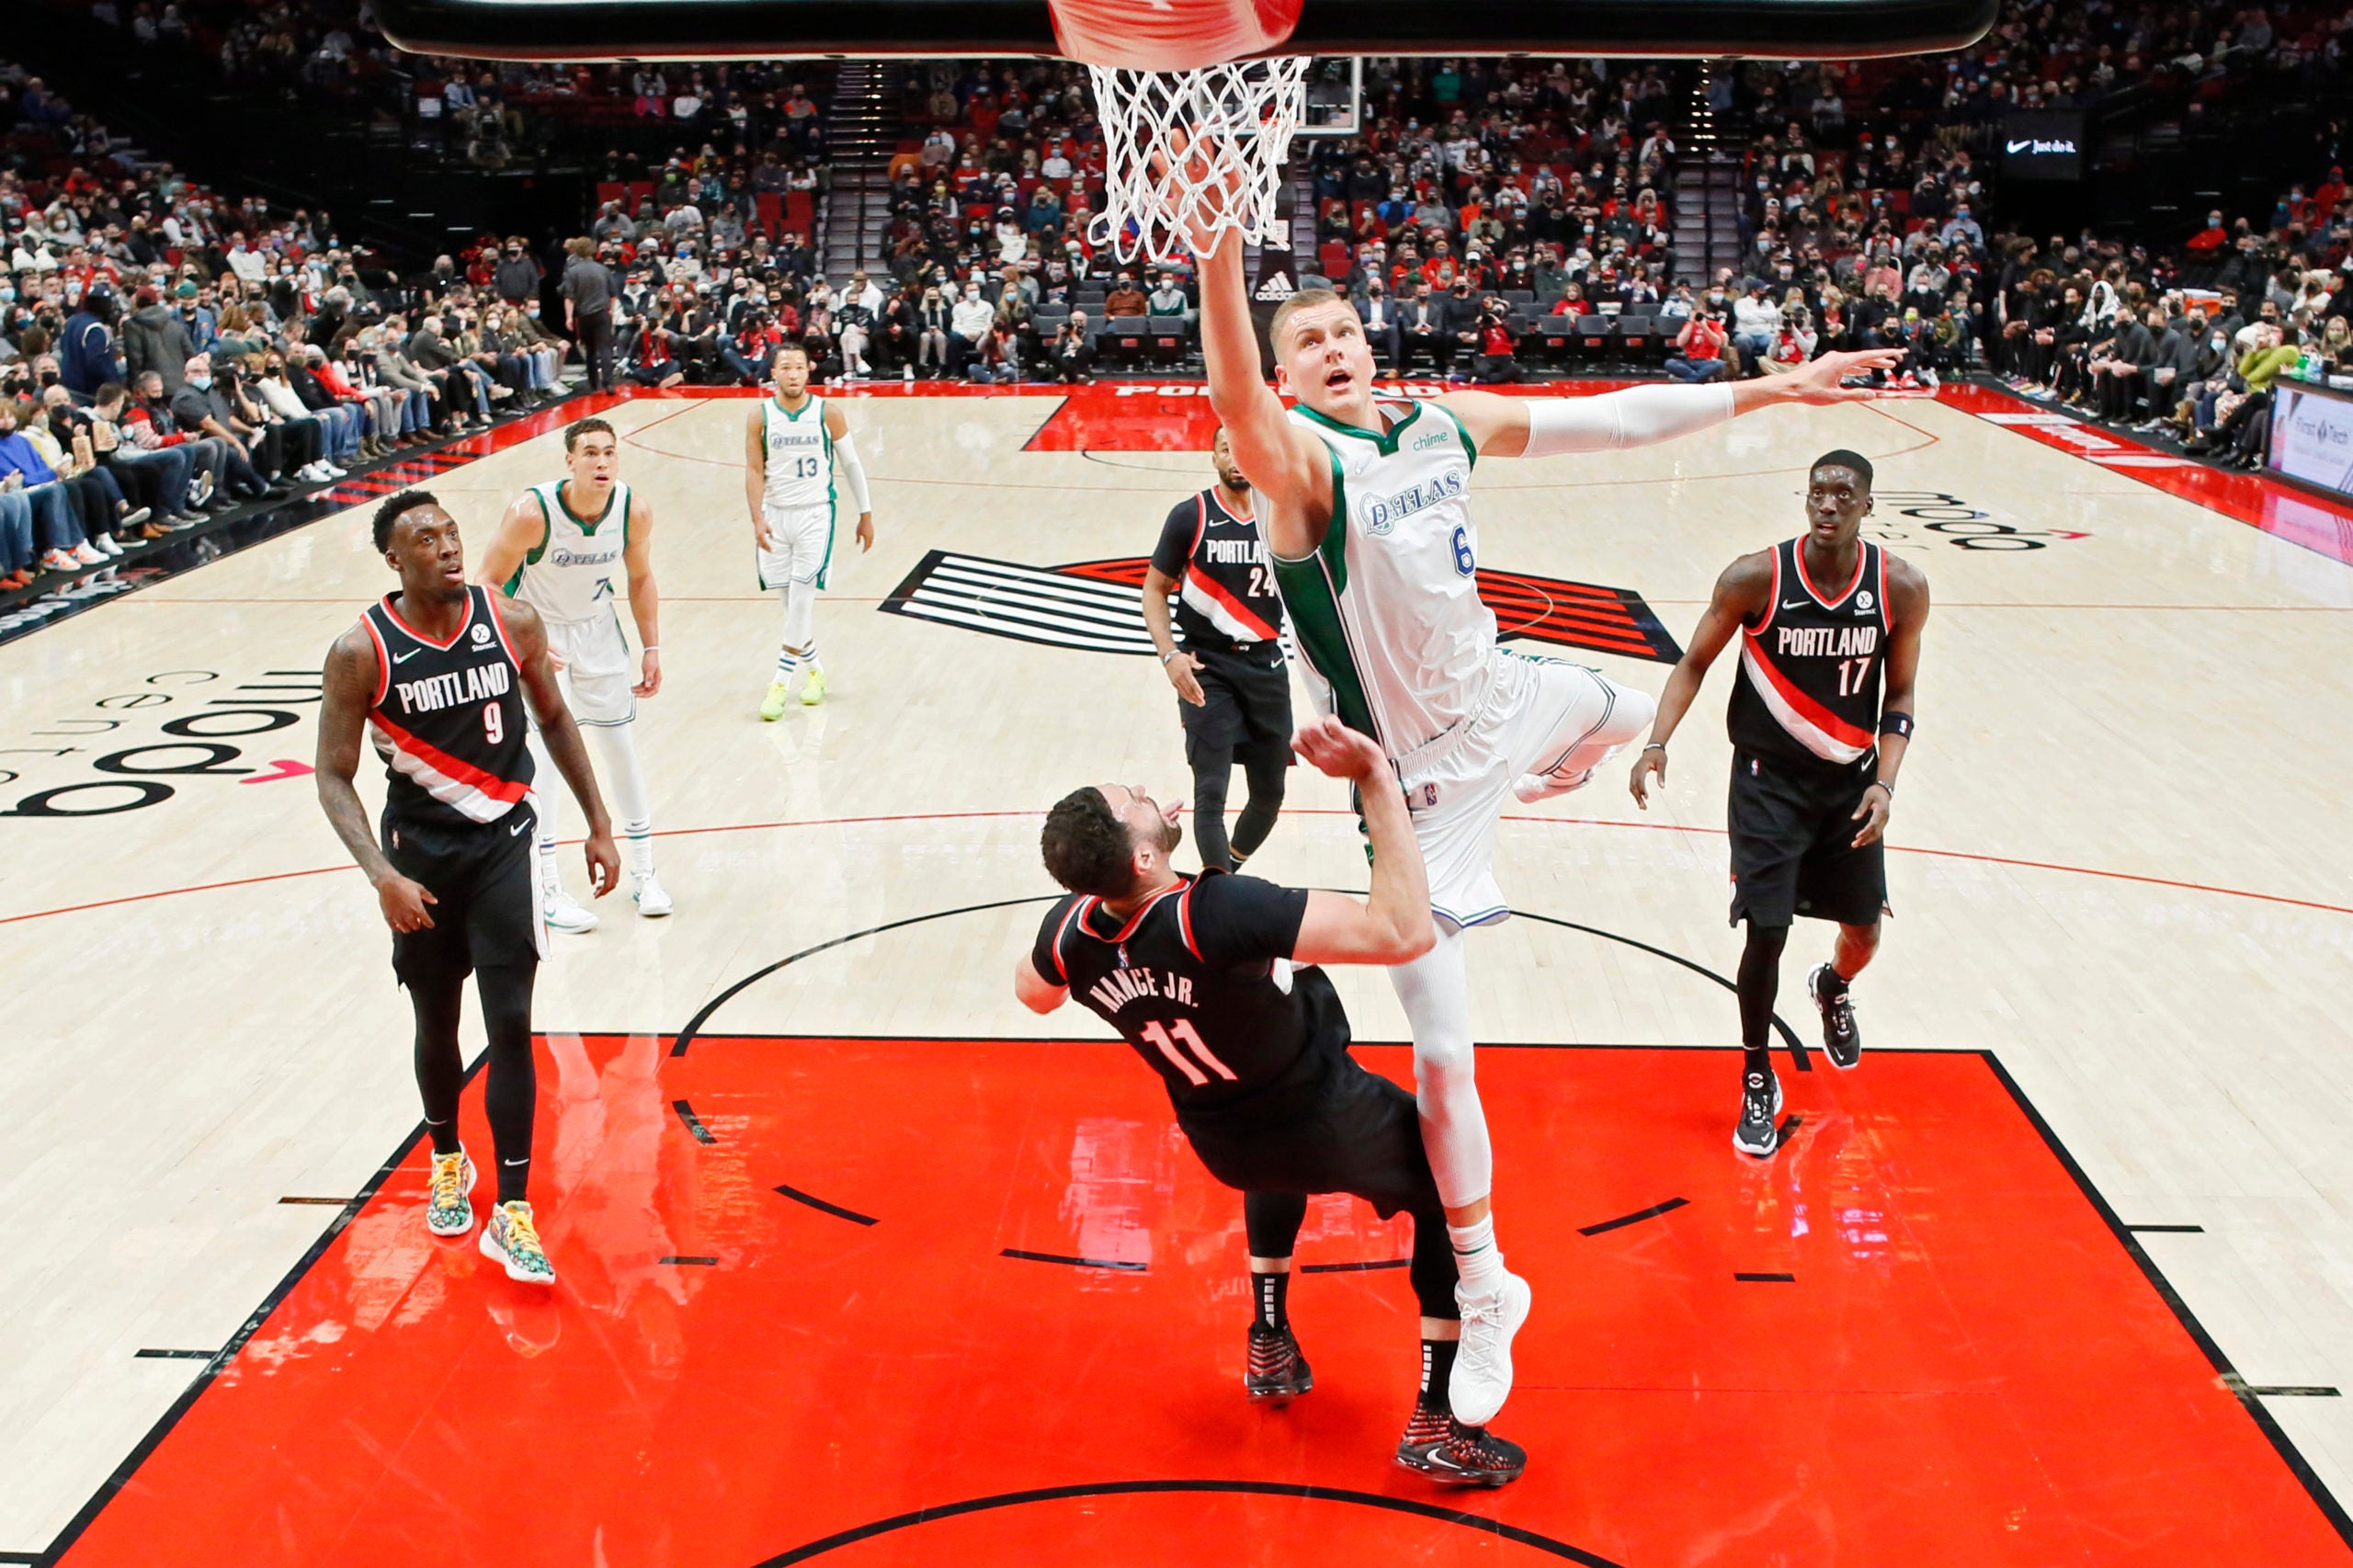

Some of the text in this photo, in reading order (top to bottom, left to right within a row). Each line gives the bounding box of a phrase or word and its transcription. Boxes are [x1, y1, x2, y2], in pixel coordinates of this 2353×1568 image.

[2031, 139, 2052, 154] Just
[2052, 139, 2065, 153] do
[1413, 429, 1449, 452] chime
[797, 458, 817, 477] 13
[1360, 470, 1463, 536] DALLAS
[1206, 540, 1267, 563] PORTLA
[1449, 523, 1474, 579] 6
[592, 576, 610, 602] 7
[1247, 567, 1275, 597] 24
[1778, 626, 1878, 656] PORTLAND
[394, 662, 510, 714] PORTLAND
[1838, 657, 1873, 697] 17
[483, 701, 505, 744] 9
[1089, 967, 1199, 1014] NANCE JR.
[1140, 1018, 1239, 1087] 11
